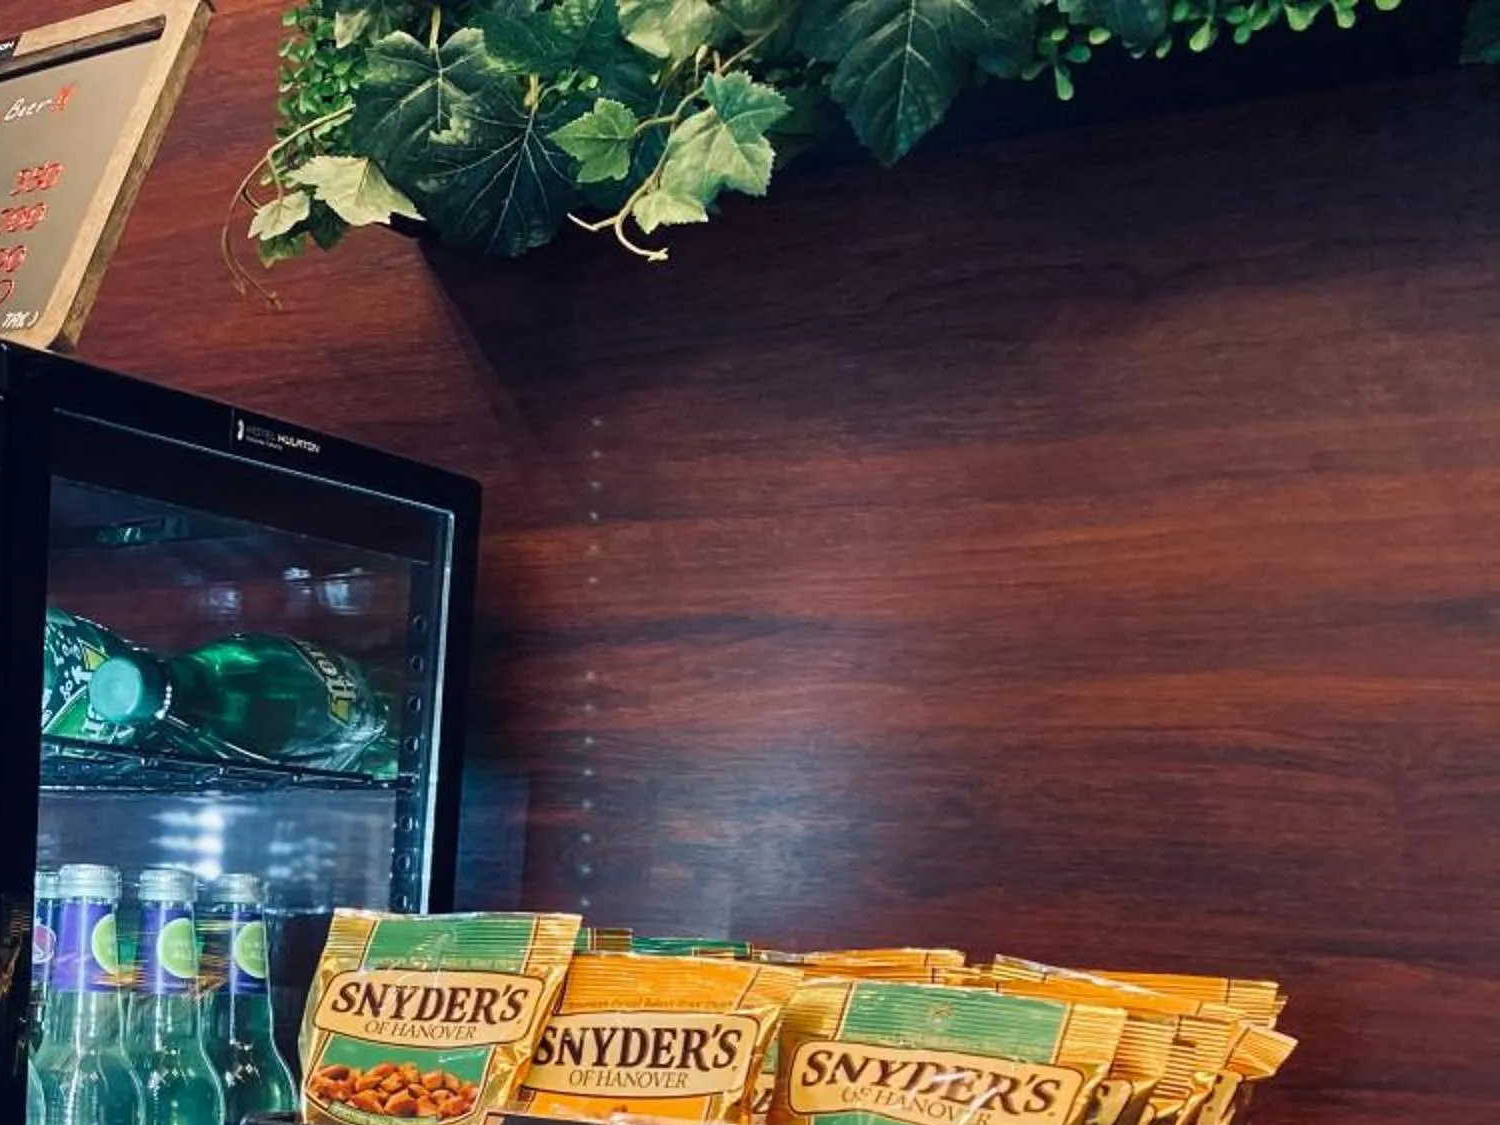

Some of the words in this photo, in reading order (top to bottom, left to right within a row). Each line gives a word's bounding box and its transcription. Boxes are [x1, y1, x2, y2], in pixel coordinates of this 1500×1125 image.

[331, 982, 528, 1026] SNYDER'S
[364, 1019, 391, 1035] OF
[390, 1021, 478, 1041] HANOVER
[532, 1024, 742, 1072] SNYDER'S
[569, 1069, 596, 1087] OF
[595, 1071, 691, 1089] HANOVER
[802, 1050, 1061, 1117] SNYDER'S
